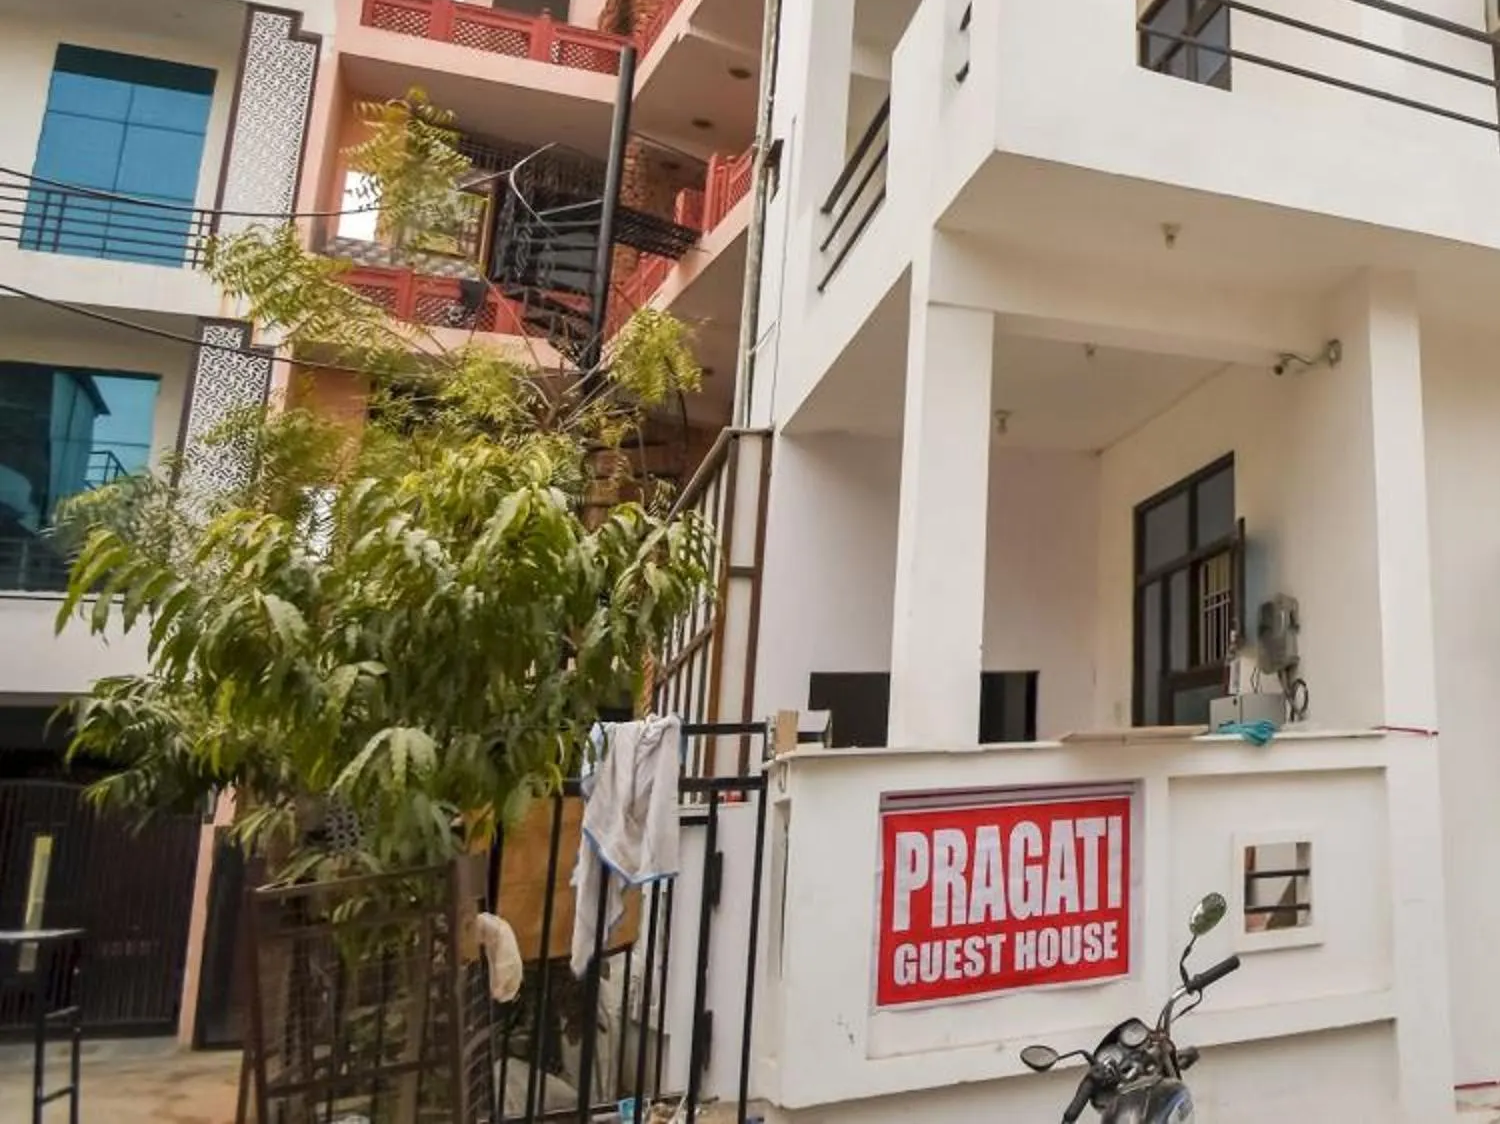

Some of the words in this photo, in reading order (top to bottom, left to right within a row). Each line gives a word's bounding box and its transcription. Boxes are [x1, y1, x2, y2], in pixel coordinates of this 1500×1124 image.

[892, 815, 1122, 932] PRAGATI
[893, 934, 1006, 986] GUEST
[1014, 921, 1118, 971] HOUSE
